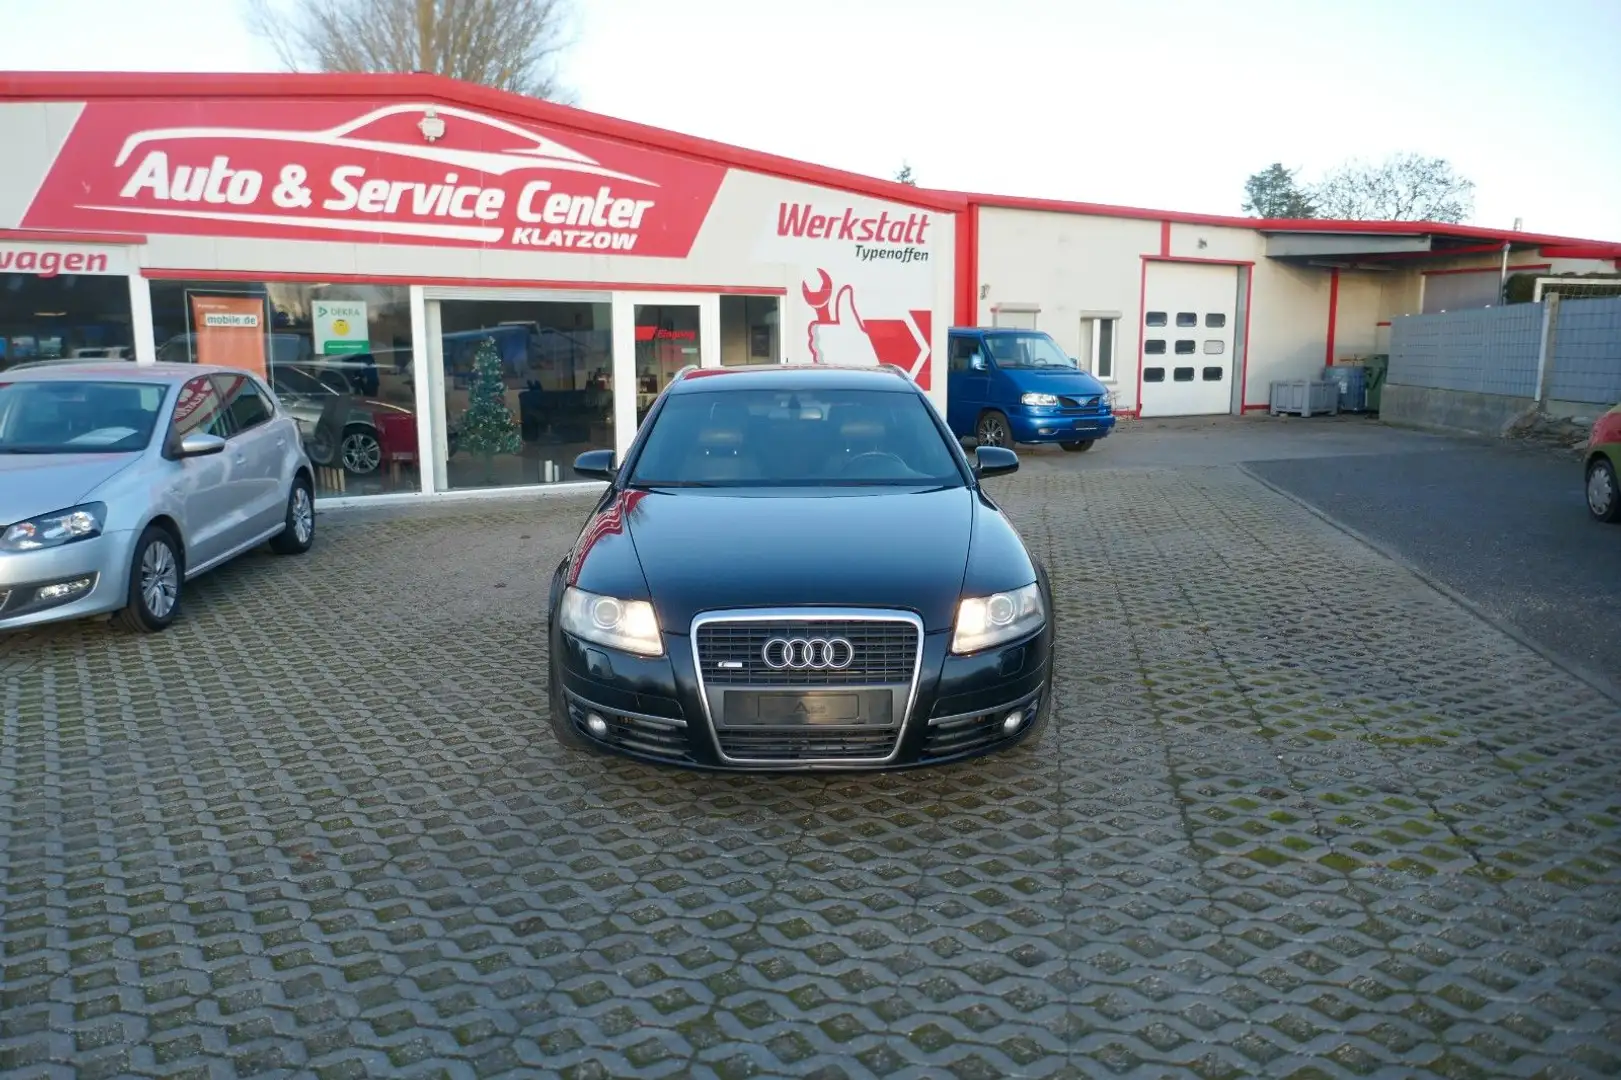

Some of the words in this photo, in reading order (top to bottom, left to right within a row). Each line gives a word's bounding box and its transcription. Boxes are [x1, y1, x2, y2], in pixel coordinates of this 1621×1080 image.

[119, 151, 263, 205] Auto
[271, 163, 312, 208] &
[322, 165, 506, 220] Service
[516, 180, 655, 229] Center
[777, 202, 930, 244] Werkstatt
[512, 227, 638, 250] KLATZOW
[855, 245, 929, 263] Typenoffen
[330, 307, 361, 316] DEKRA
